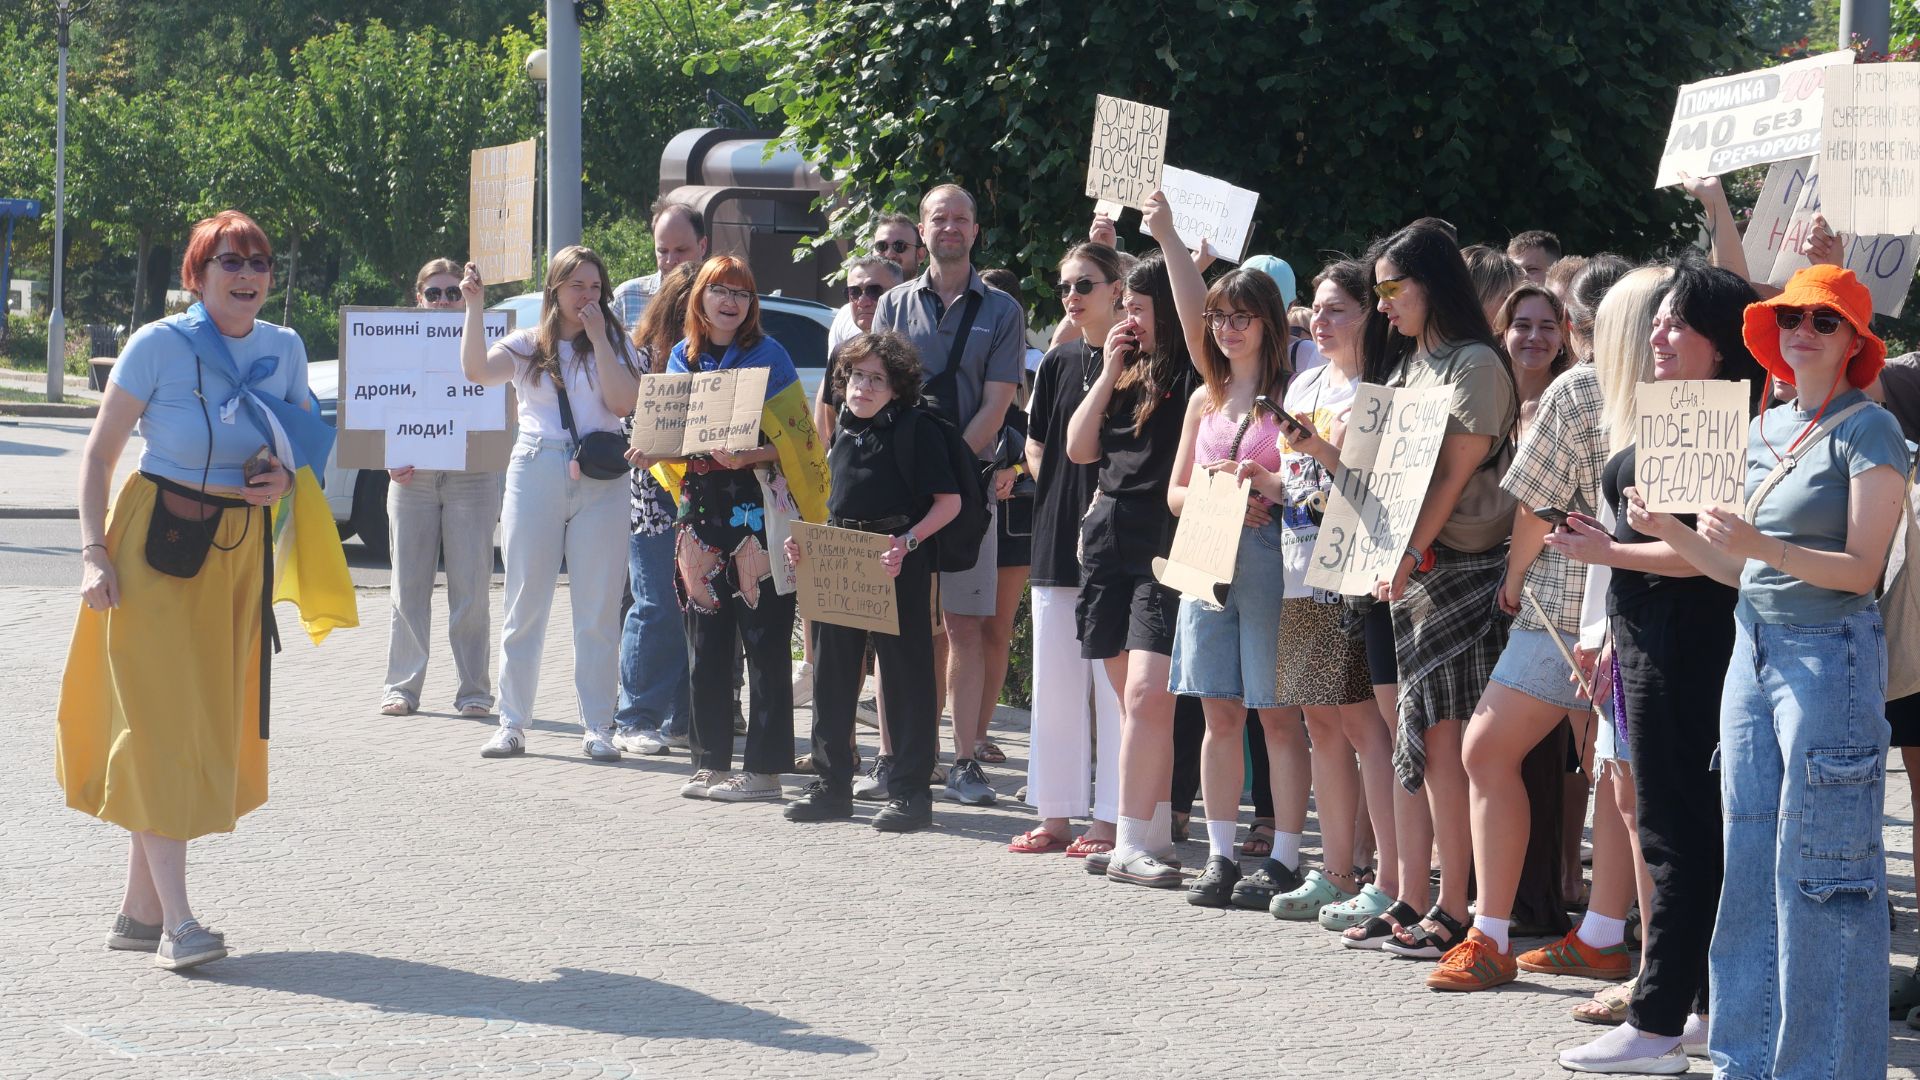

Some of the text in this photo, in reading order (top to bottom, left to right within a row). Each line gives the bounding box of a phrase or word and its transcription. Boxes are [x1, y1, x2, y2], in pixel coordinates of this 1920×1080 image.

[1681, 67, 1825, 115] ПОМИЛКА 40
[1096, 97, 1164, 135] КОМУ ВИ
[1666, 108, 1802, 156] МО БЕЗ
[353, 321, 505, 338] Повинні вмити
[355, 384, 484, 400] дрони, а не
[397, 420, 454, 438] люди!
[1358, 397, 1394, 435] ЗА
[1641, 410, 1740, 450] ПОВЕРНИ
[1640, 448, 1747, 504] ФЕДОРОВА
[806, 528, 835, 540] ЧОМУ
[806, 541, 813, 555] В
[867, 549, 882, 560] БУТ
[1319, 526, 1356, 573] ЗА
[811, 557, 849, 572] ТАКИЙ
[814, 576, 831, 590] ЩО
[843, 576, 849, 590] В
